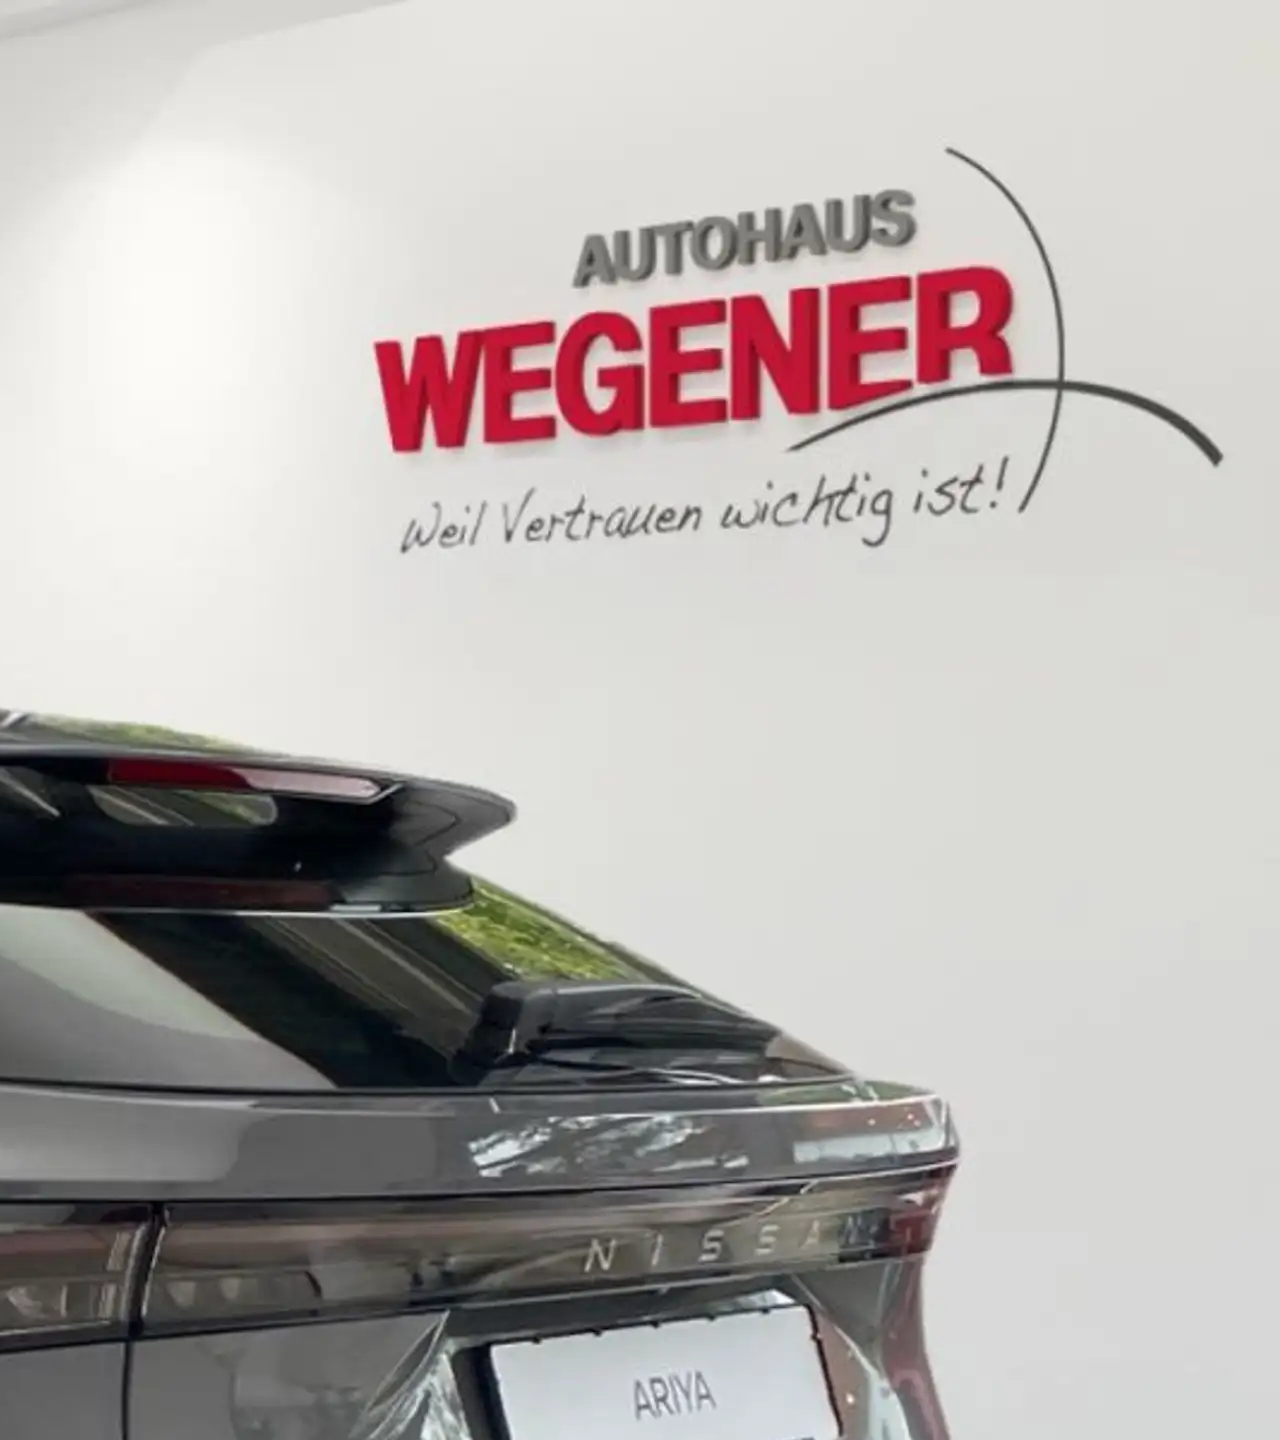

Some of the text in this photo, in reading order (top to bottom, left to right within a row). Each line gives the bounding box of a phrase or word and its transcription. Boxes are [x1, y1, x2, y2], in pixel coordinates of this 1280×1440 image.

[572, 190, 917, 288] AUTOHAUS
[375, 266, 1014, 453] WEGENER
[399, 456, 1010, 554] Weil Vertrauen wichtig ist!
[634, 1370, 716, 1420] ARIYA
